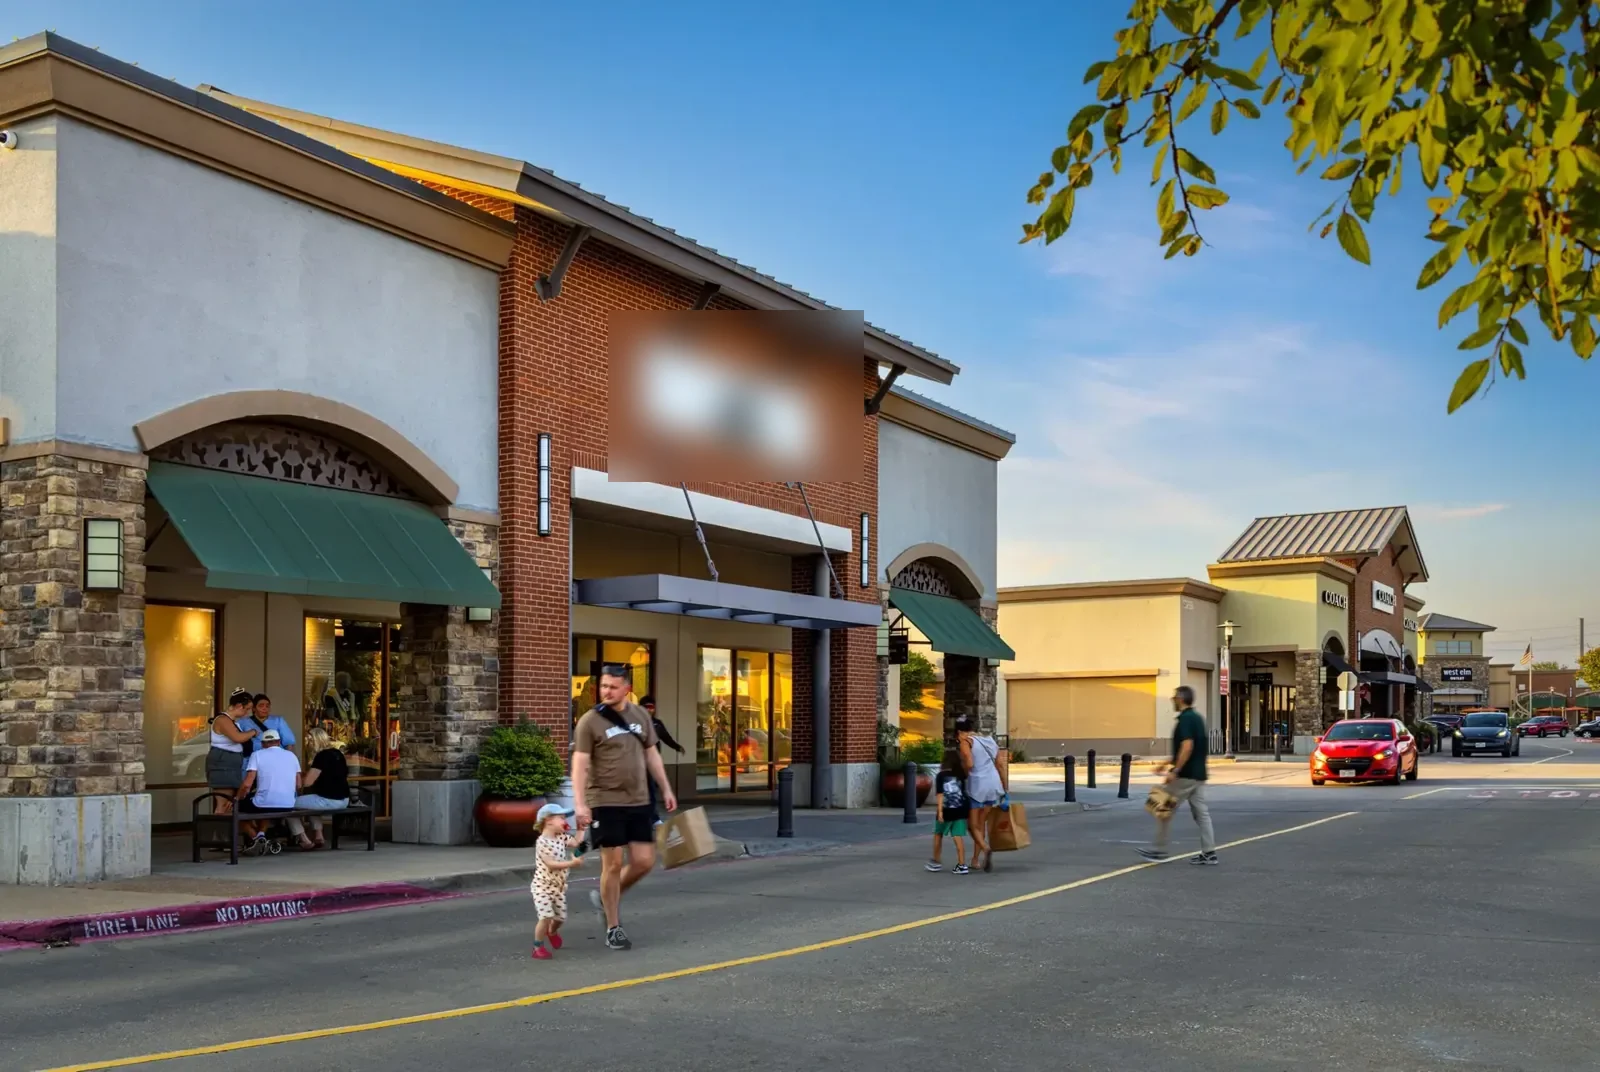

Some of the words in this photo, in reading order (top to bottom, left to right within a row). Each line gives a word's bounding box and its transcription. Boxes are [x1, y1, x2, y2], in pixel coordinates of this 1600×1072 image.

[1324, 590, 1348, 609] COACH
[1377, 590, 1397, 607] COACH
[1459, 668, 1472, 676] elm
[84, 917, 128, 938] FIRE
[132, 912, 180, 932] LANE
[216, 907, 238, 923] NO
[241, 900, 308, 920] PARKING
